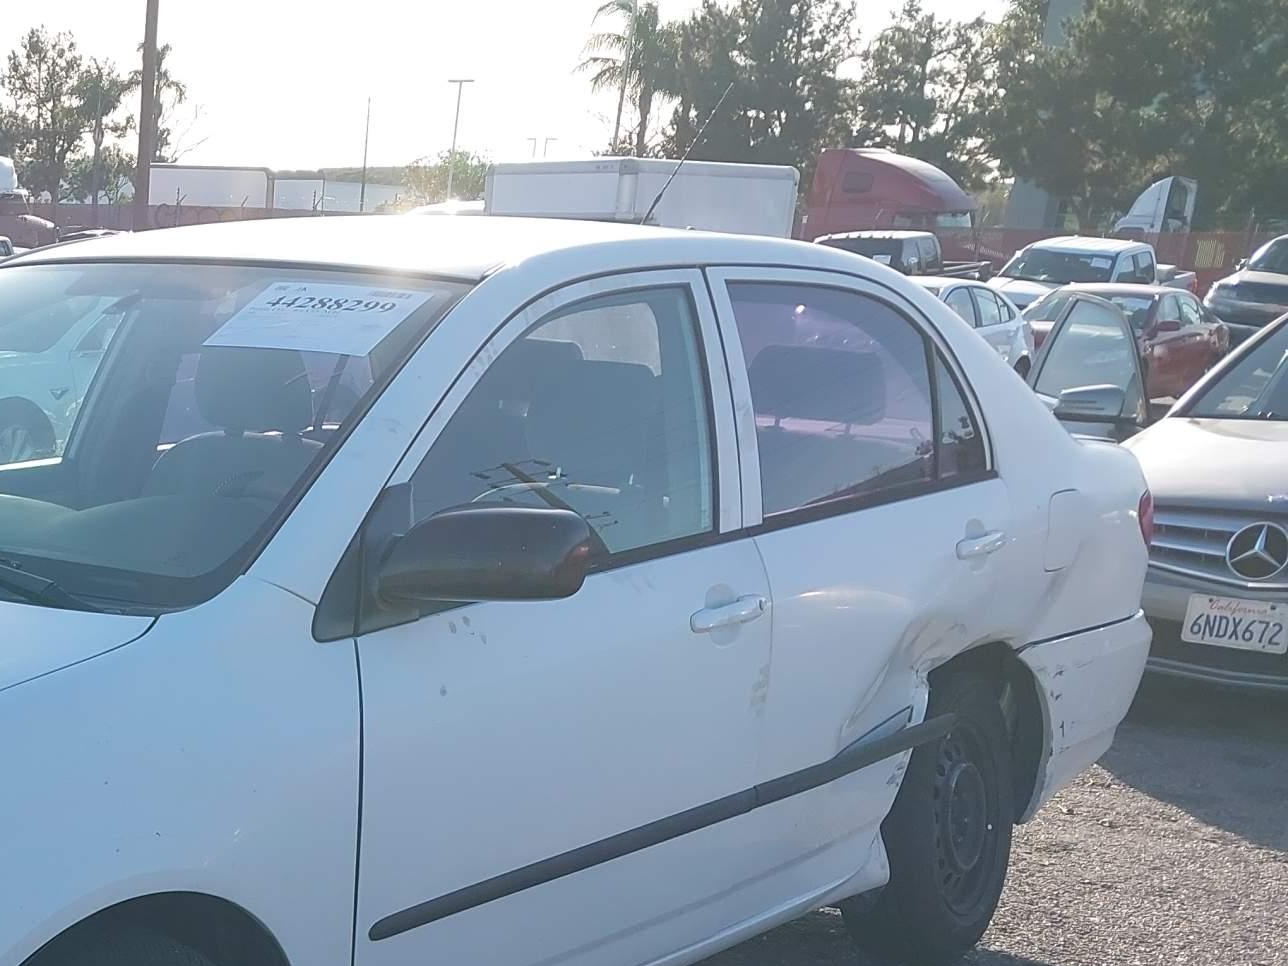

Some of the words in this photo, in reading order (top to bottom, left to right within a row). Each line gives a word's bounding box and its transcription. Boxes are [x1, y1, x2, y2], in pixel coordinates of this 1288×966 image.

[265, 295, 397, 312] 44288299
[1209, 599, 1269, 615] California
[1190, 612, 1283, 646] 6NDX672
